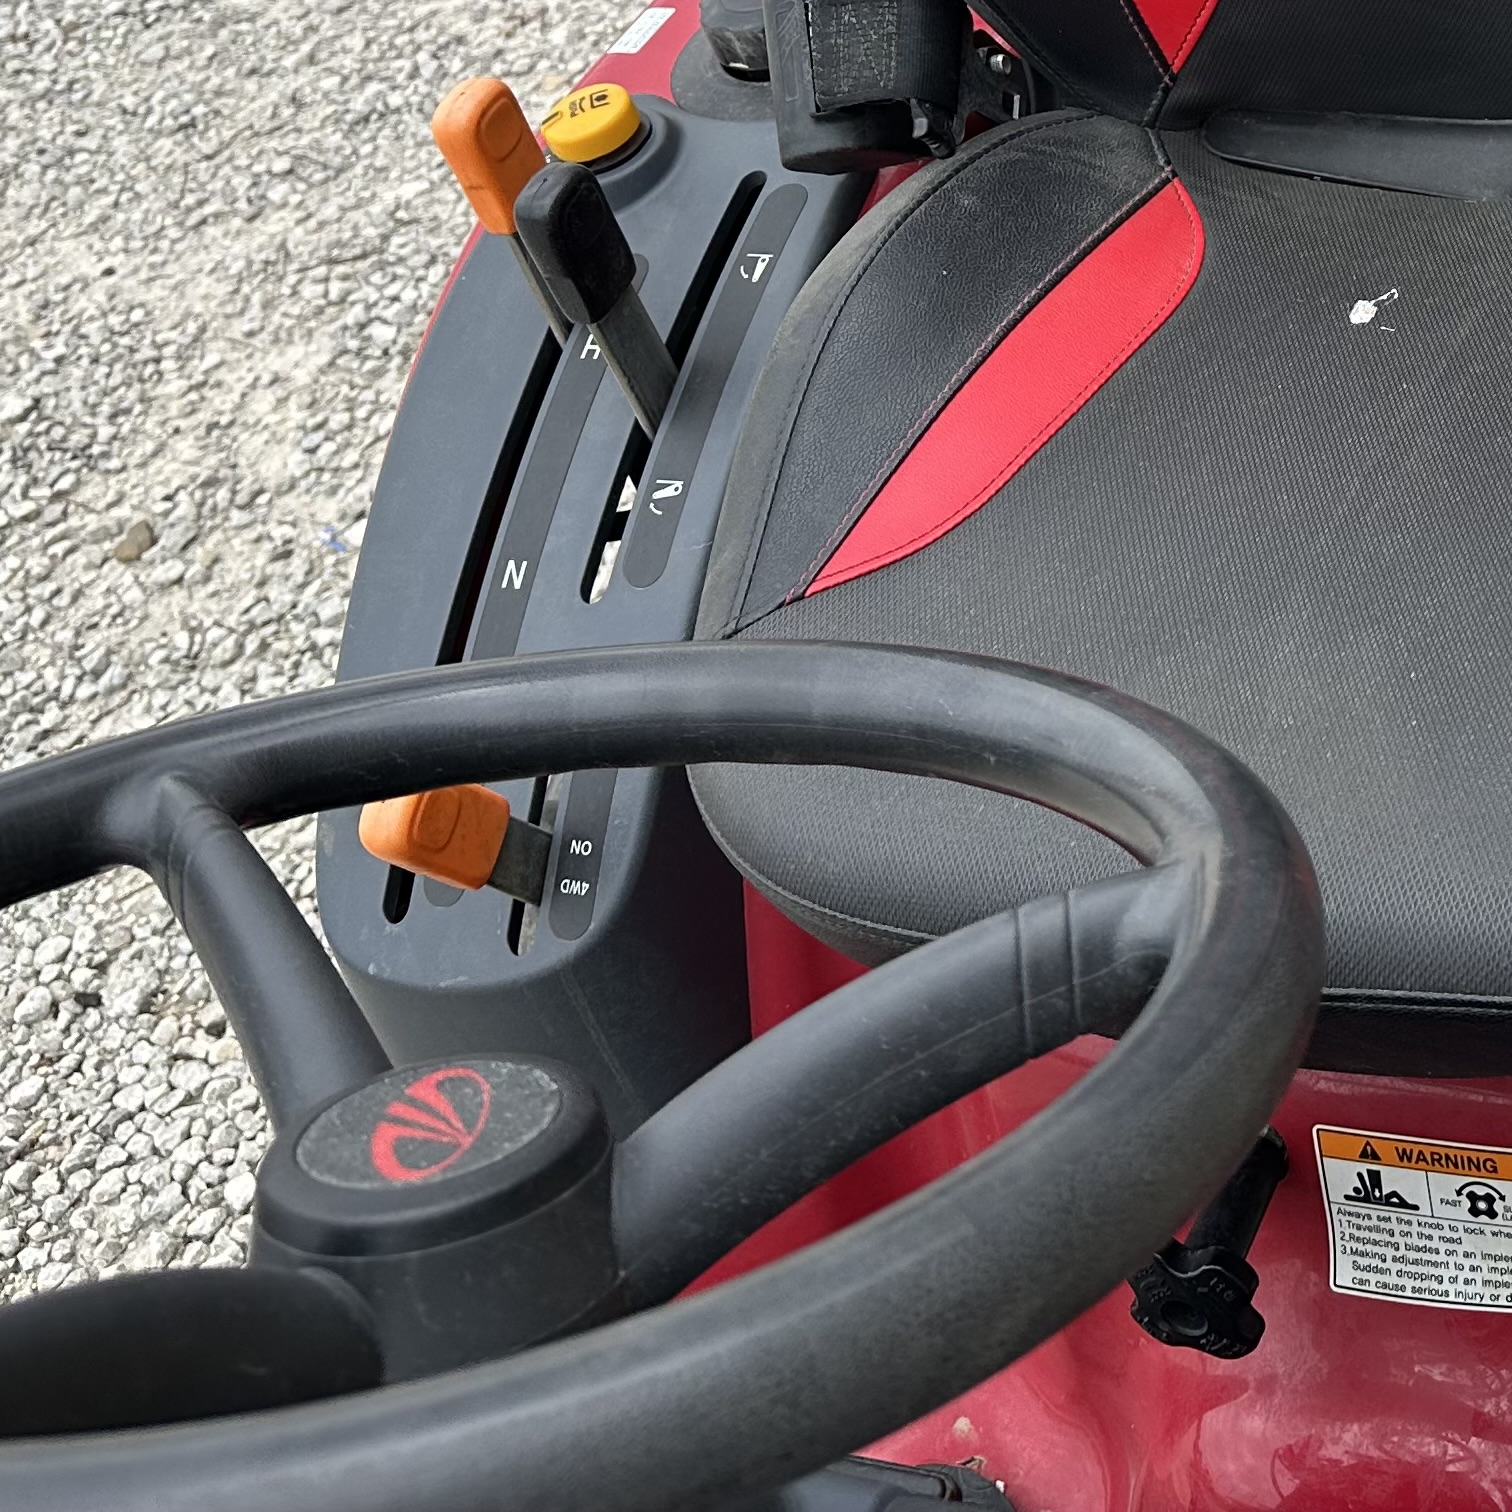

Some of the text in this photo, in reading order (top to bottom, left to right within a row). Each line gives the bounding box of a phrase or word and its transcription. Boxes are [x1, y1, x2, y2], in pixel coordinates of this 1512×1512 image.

[502, 560, 528, 590] N
[570, 840, 592, 856] ON
[560, 879, 590, 896] 4WD
[1394, 1146, 1498, 1174] WARNING
[1440, 1198, 1462, 1207] FAST
[1337, 1207, 1372, 1221] Always
[1376, 1214, 1392, 1223] set
[1396, 1216, 1412, 1226] the
[1417, 1219, 1444, 1231] knob
[1448, 1224, 1459, 1233] to
[1463, 1225, 1486, 1236] lock
[1399, 1230, 1412, 1238] on
[1417, 1231, 1434, 1242] the
[1438, 1236, 1462, 1245] road
[1404, 1242, 1440, 1255] blades
[1444, 1248, 1458, 1257] on
[1462, 1250, 1476, 1259] an
[1352, 1260, 1391, 1276] Sudden
[1396, 1268, 1444, 1285] dropping
[1448, 1275, 1458, 1284] of
[1463, 1277, 1477, 1286] an
[1391, 1255, 1450, 1270] adjustment
[1454, 1262, 1465, 1271] to
[1468, 1264, 1482, 1273] an
[1352, 1277, 1371, 1287] can
[1375, 1280, 1406, 1293] cause
[1411, 1286, 1450, 1298] serious
[1454, 1288, 1484, 1302] injury
[1489, 1293, 1501, 1302] or
